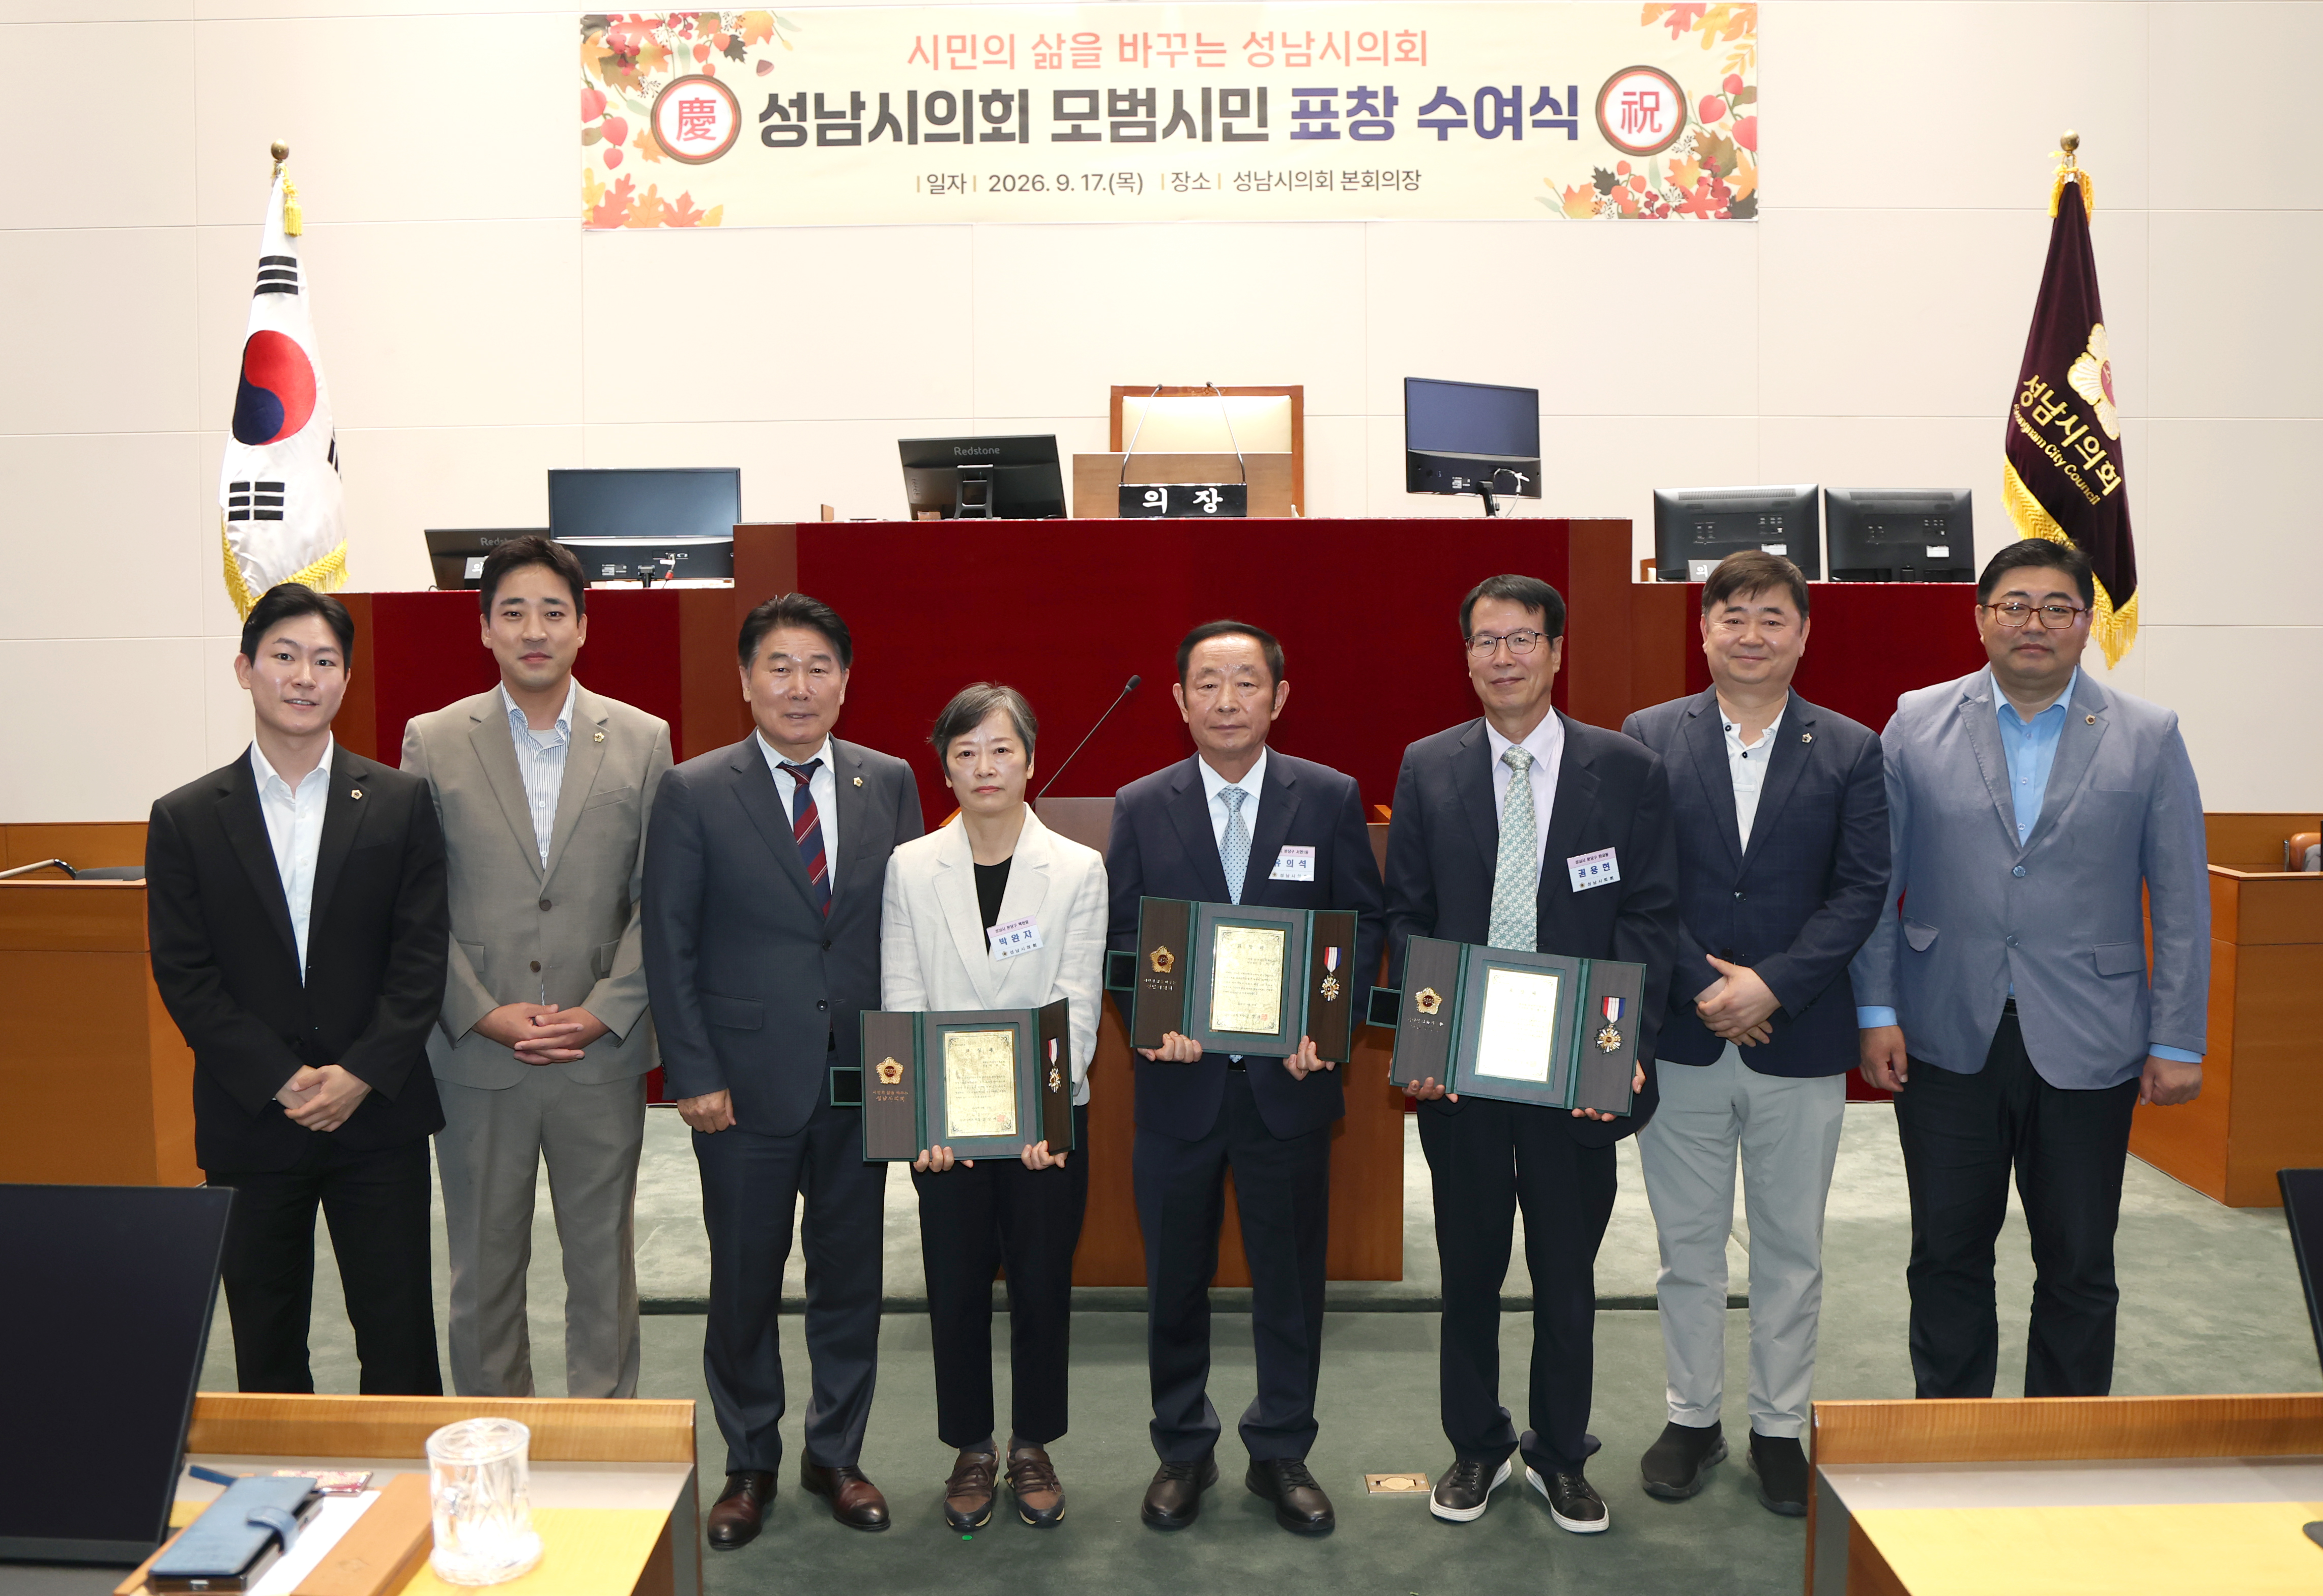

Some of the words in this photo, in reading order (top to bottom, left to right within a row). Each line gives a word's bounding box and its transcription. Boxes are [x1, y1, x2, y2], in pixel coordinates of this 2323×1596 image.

[907, 33, 1017, 70] 시민의
[1031, 32, 1102, 70] 삶을
[1119, 31, 1227, 69] 바꾸는
[1242, 29, 1428, 68] 성남시의회
[676, 97, 717, 142] 慶
[758, 88, 1030, 147] 성남시의회
[1051, 86, 1269, 143] 모범시민
[1290, 85, 1399, 141] 표창
[1417, 84, 1579, 141] 수여식
[1620, 91, 1663, 134] 祝
[926, 173, 967, 194] 일자
[989, 174, 1050, 192] 2026.
[1056, 174, 1075, 192] 9.
[1081, 172, 1144, 195] 17.(목)
[1171, 171, 1211, 192] 장소
[1233, 170, 1333, 192] 성남시의회
[1340, 169, 1422, 191] 본회의장
[954, 447, 1000, 455] Redstone
[2013, 403, 2047, 449] Seongnam
[2044, 444, 2067, 467] City
[2064, 464, 2101, 505] Council
[2020, 374, 2122, 496] 성남시의회
[1142, 488, 1224, 515] 의장
[480, 537, 507, 546] Reds
[999, 930, 1032, 945] 박완자
